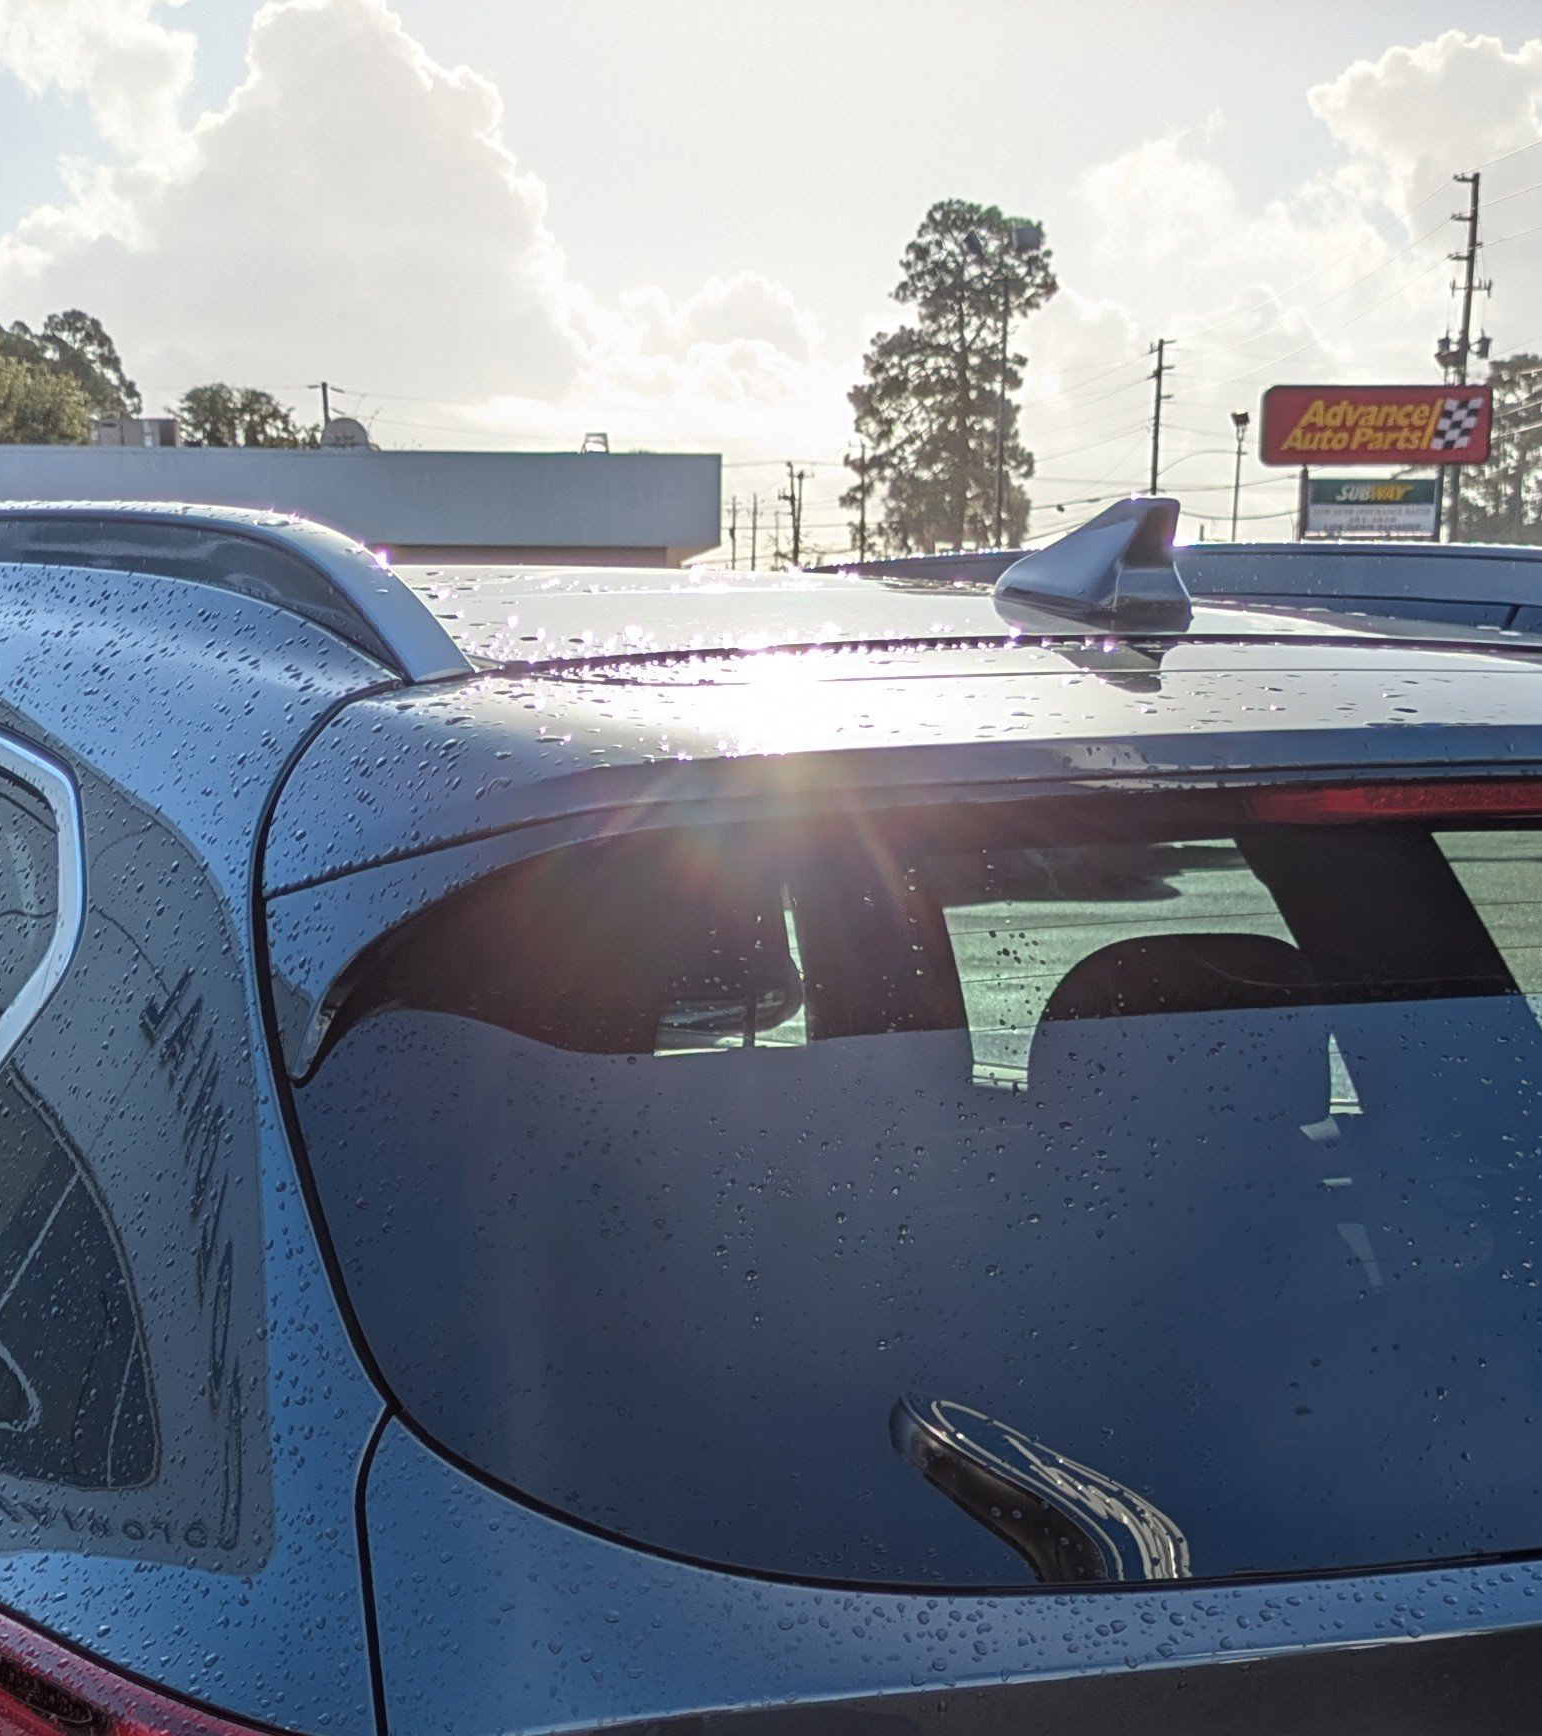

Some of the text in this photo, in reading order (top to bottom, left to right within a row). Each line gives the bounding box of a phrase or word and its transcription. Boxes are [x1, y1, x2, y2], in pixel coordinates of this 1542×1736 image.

[1299, 399, 1430, 427] Advance
[1279, 427, 1422, 451] Auto Parts
